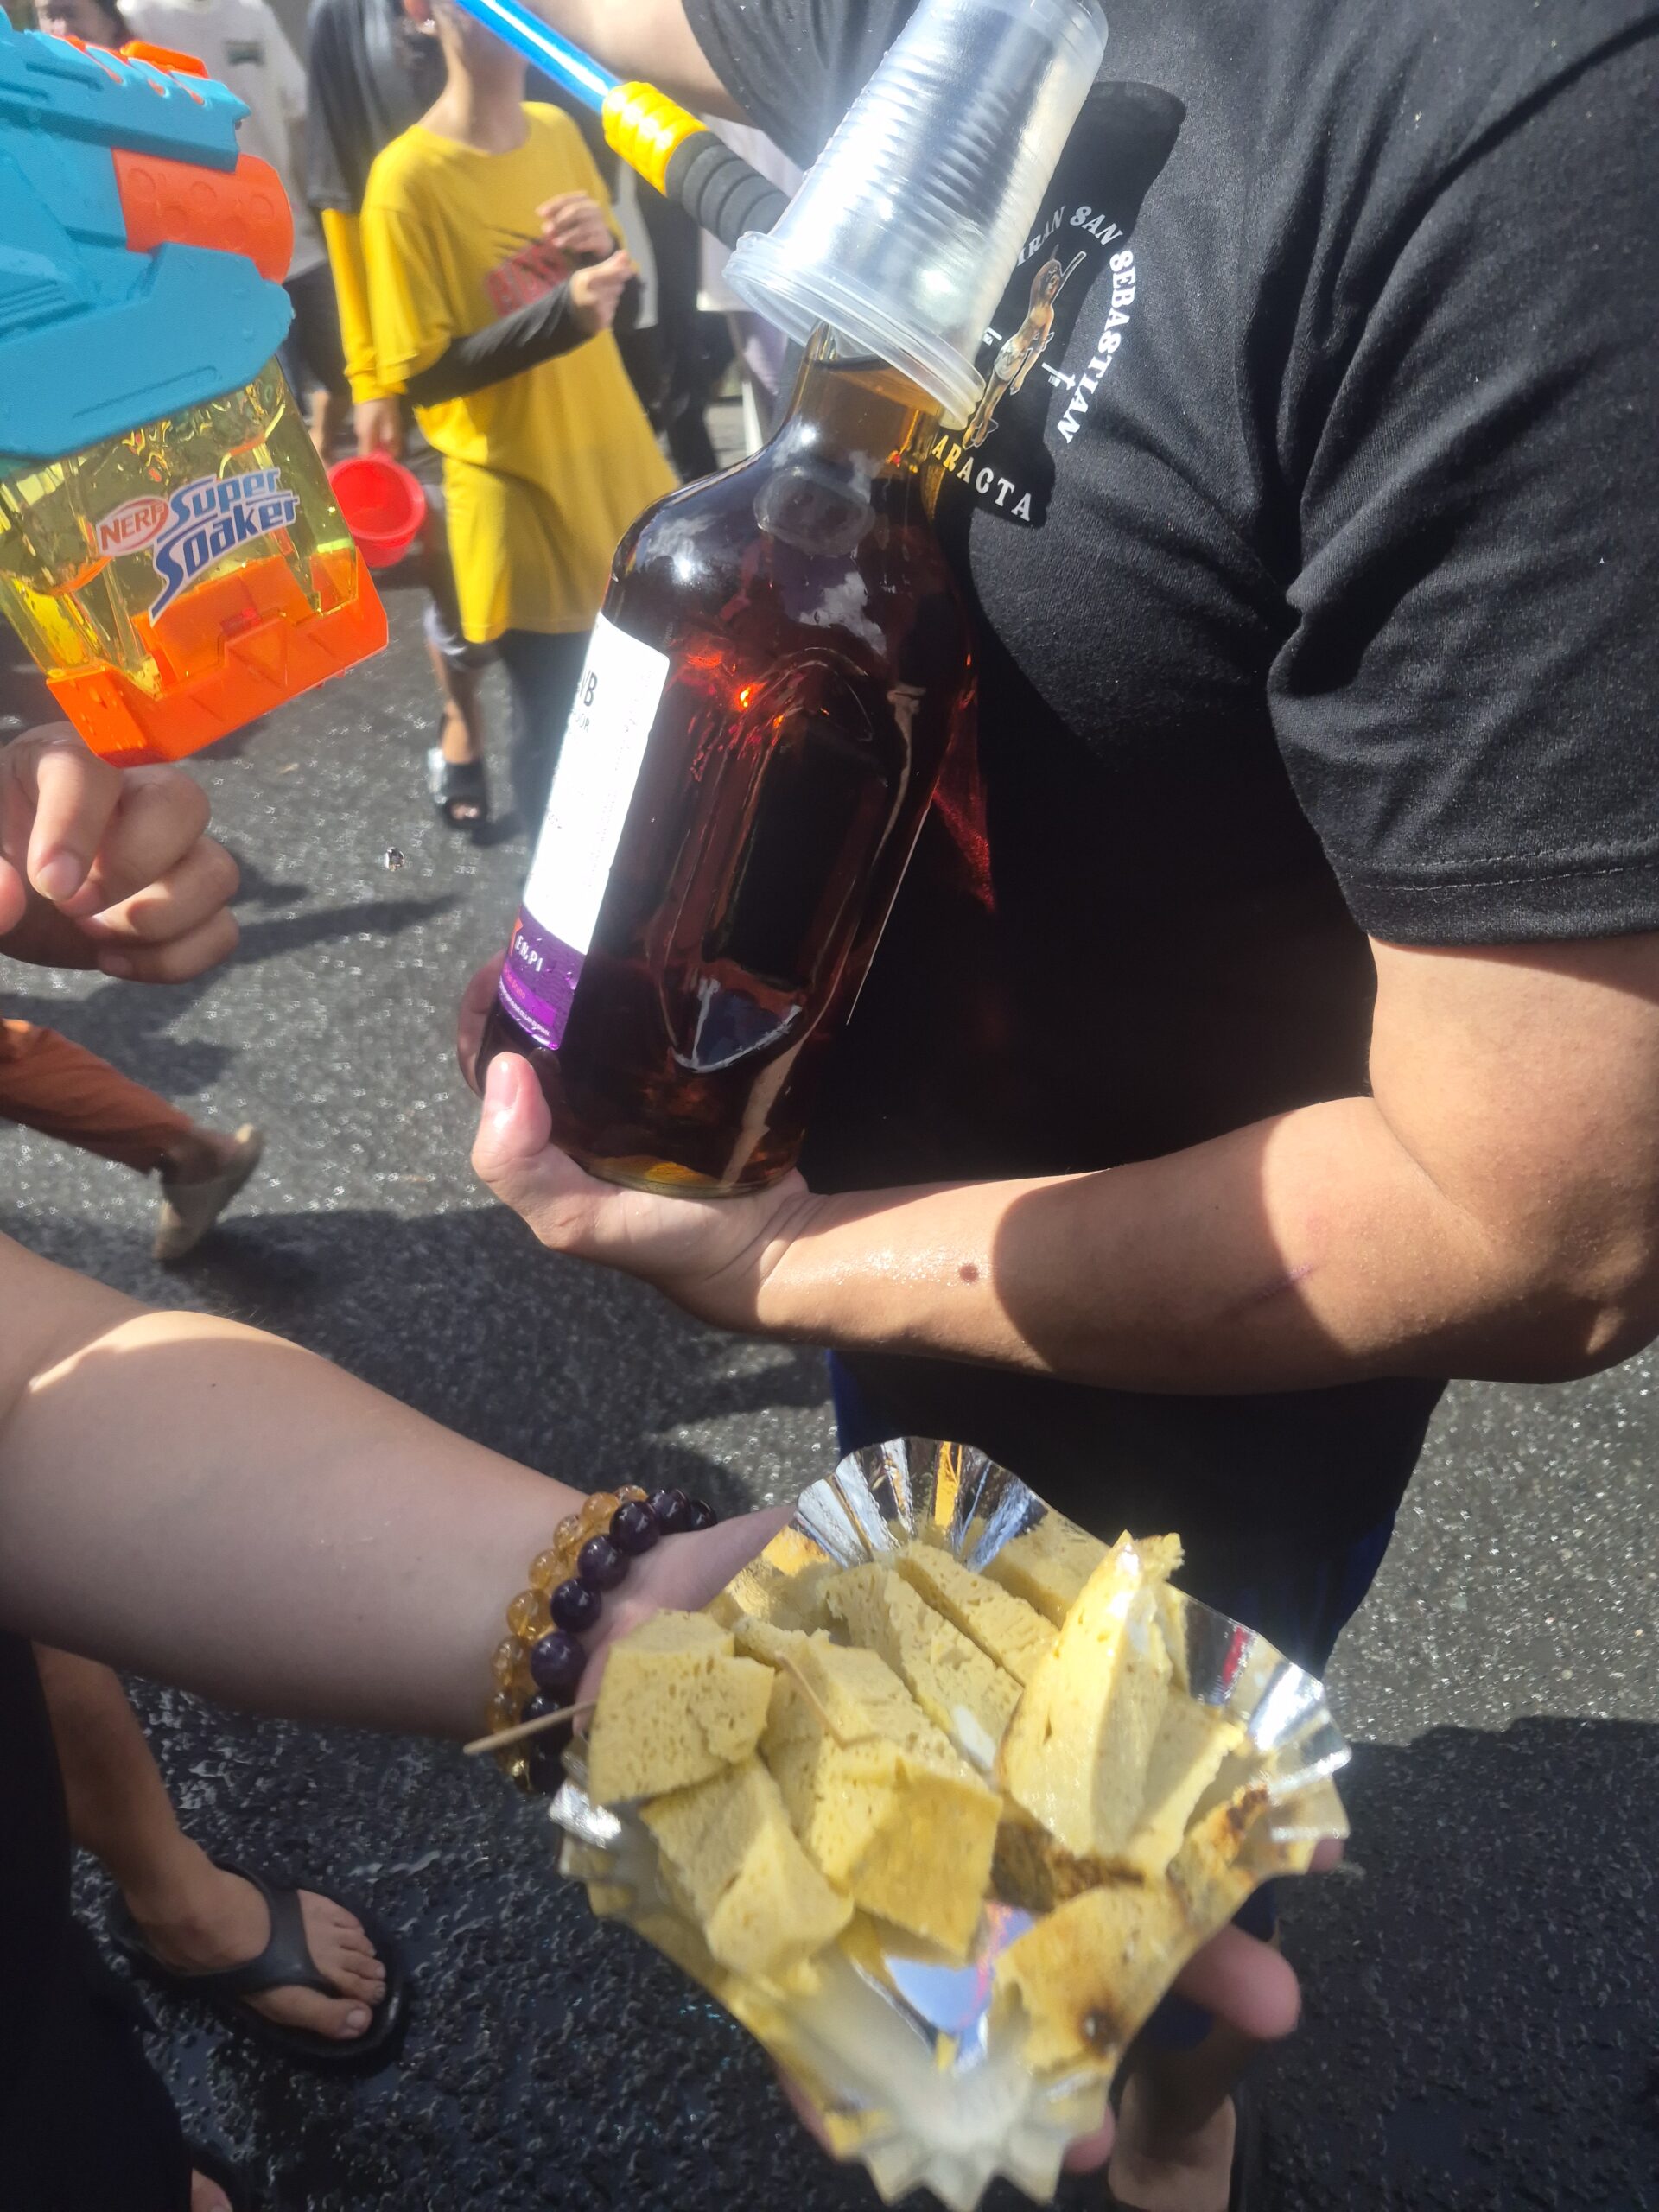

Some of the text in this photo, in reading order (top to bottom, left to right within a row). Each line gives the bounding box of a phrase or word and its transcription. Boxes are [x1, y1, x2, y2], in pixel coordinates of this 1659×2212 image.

[1069, 206, 1123, 245] SAN
[1057, 250, 1137, 444] SEBASTIAN
[99, 504, 165, 551] NERF
[156, 469, 280, 544] Super
[151, 493, 299, 620] Soaker
